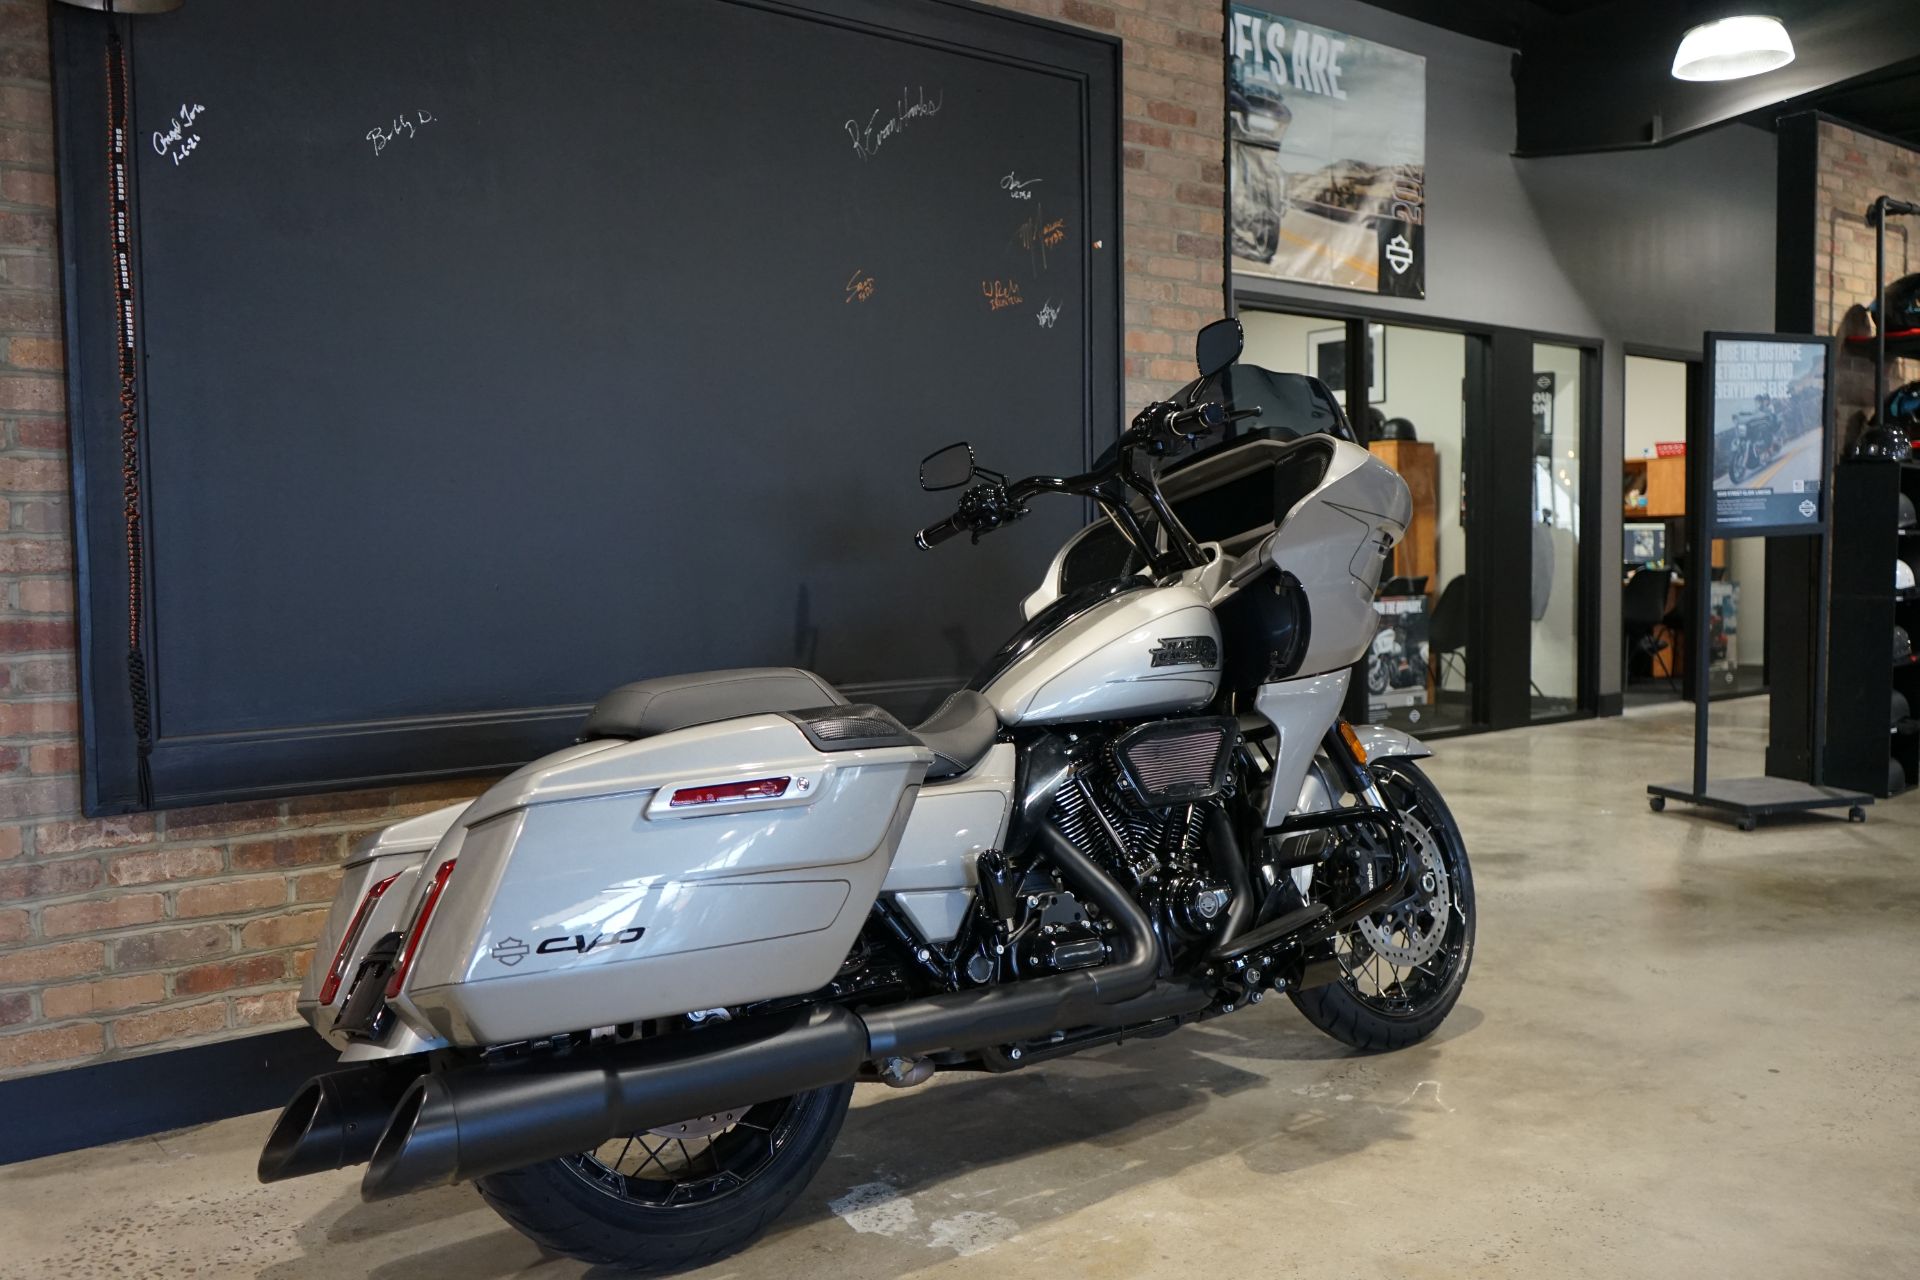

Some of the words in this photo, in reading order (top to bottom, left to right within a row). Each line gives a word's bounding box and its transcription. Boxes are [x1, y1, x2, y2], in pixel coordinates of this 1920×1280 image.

[1292, 28, 1347, 101] ARE
[1716, 343, 1739, 361] LOSE
[1716, 362, 1754, 379] ETWEEN
[1715, 381, 1767, 399] VERYTHING
